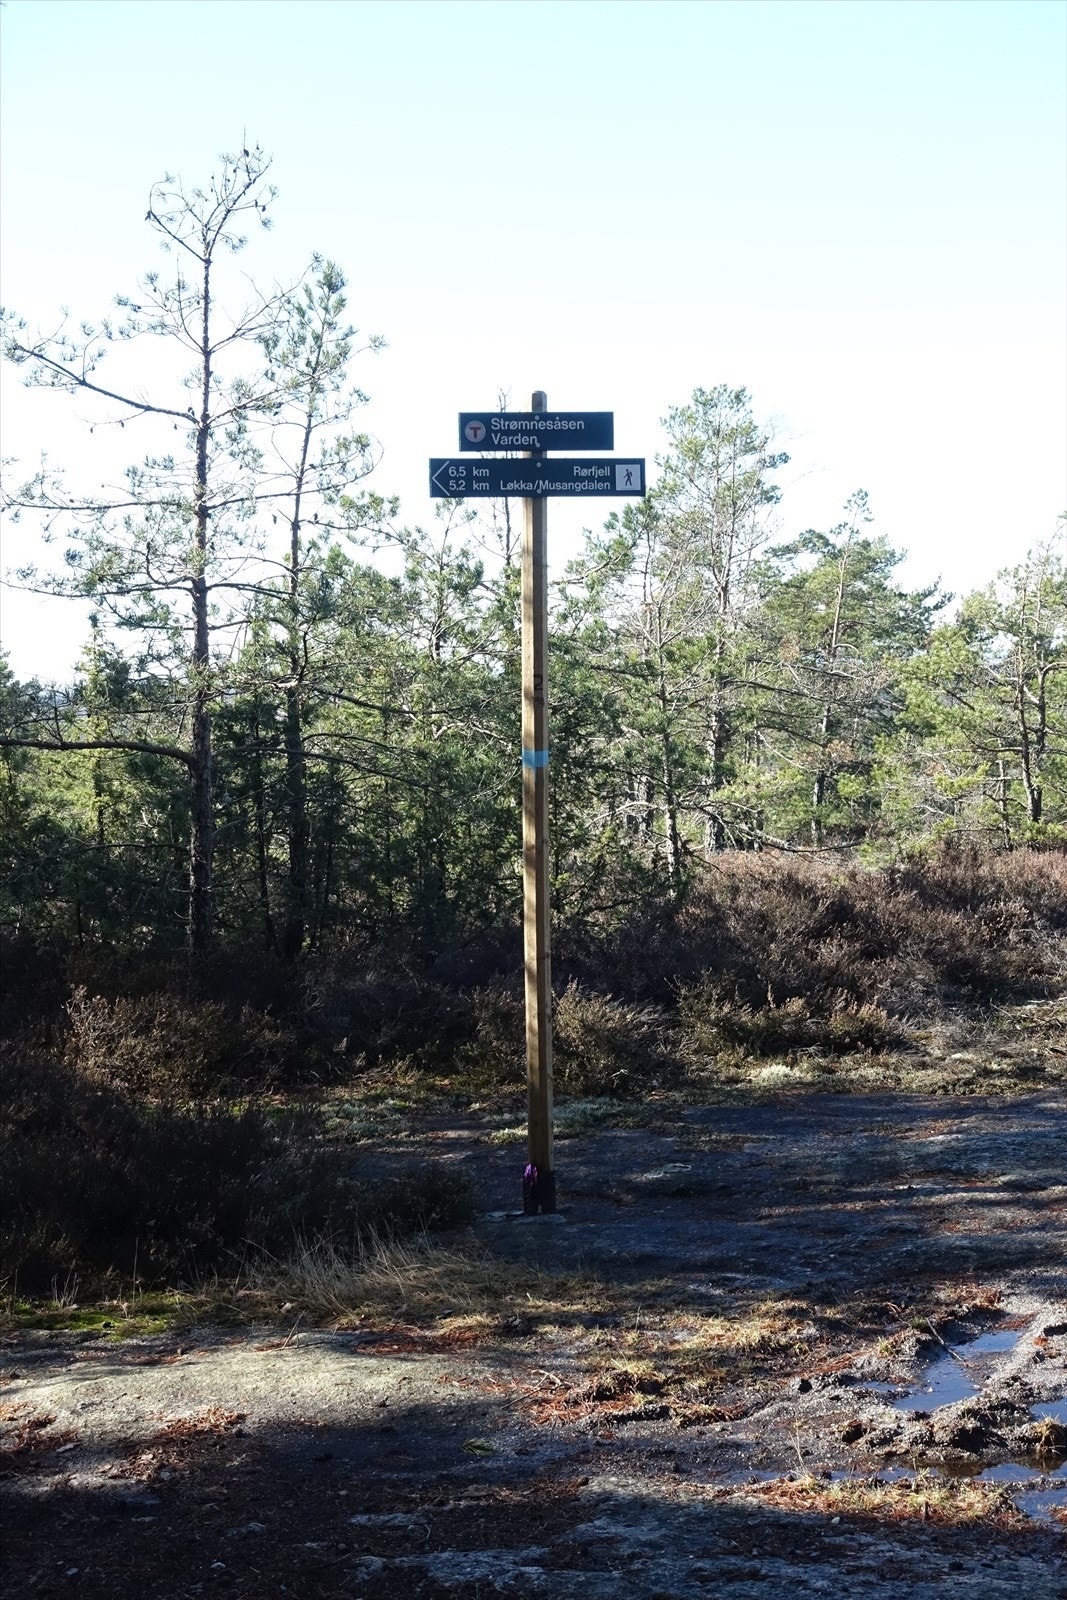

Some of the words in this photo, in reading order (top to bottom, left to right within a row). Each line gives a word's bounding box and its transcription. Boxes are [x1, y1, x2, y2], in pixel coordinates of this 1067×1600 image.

[491, 416, 585, 430] Strømnesåsen
[469, 426, 481, 438] T
[491, 433, 538, 445] Varden
[448, 466, 466, 478] 6,5
[473, 466, 490, 477] km
[573, 466, 611, 478] Rørfjell
[449, 480, 466, 491] 5,2
[473, 479, 490, 490] km
[500, 479, 611, 493] Løkka/Musangdalen
[534, 674, 543, 690] 2
